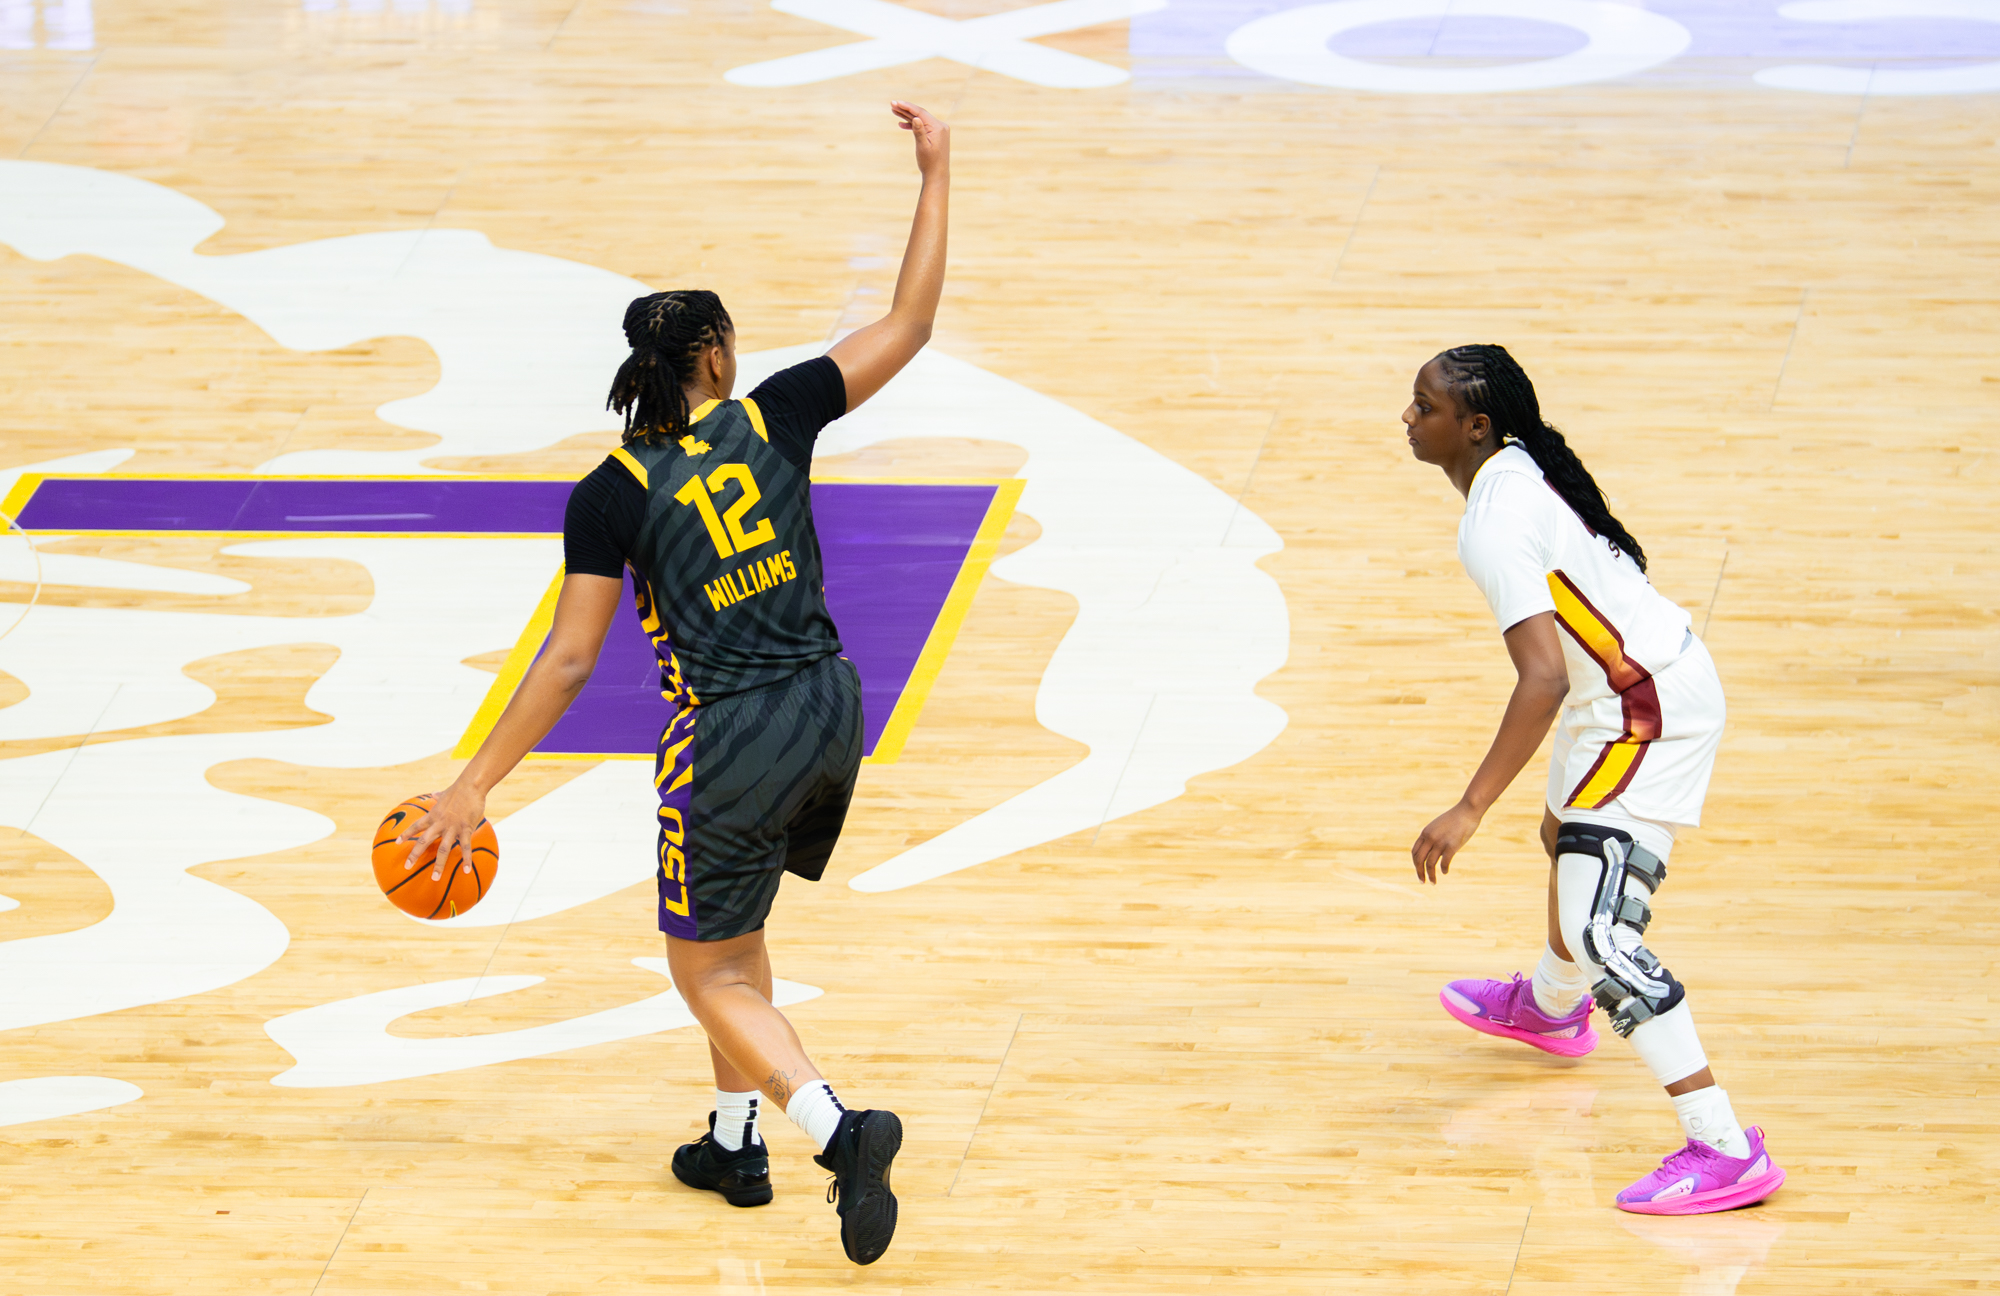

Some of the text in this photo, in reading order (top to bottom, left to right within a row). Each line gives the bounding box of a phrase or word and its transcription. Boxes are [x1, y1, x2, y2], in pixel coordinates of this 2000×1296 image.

[674, 463, 776, 559] 12
[703, 550, 797, 612] WILLIAMS
[658, 806, 690, 917] LSU
